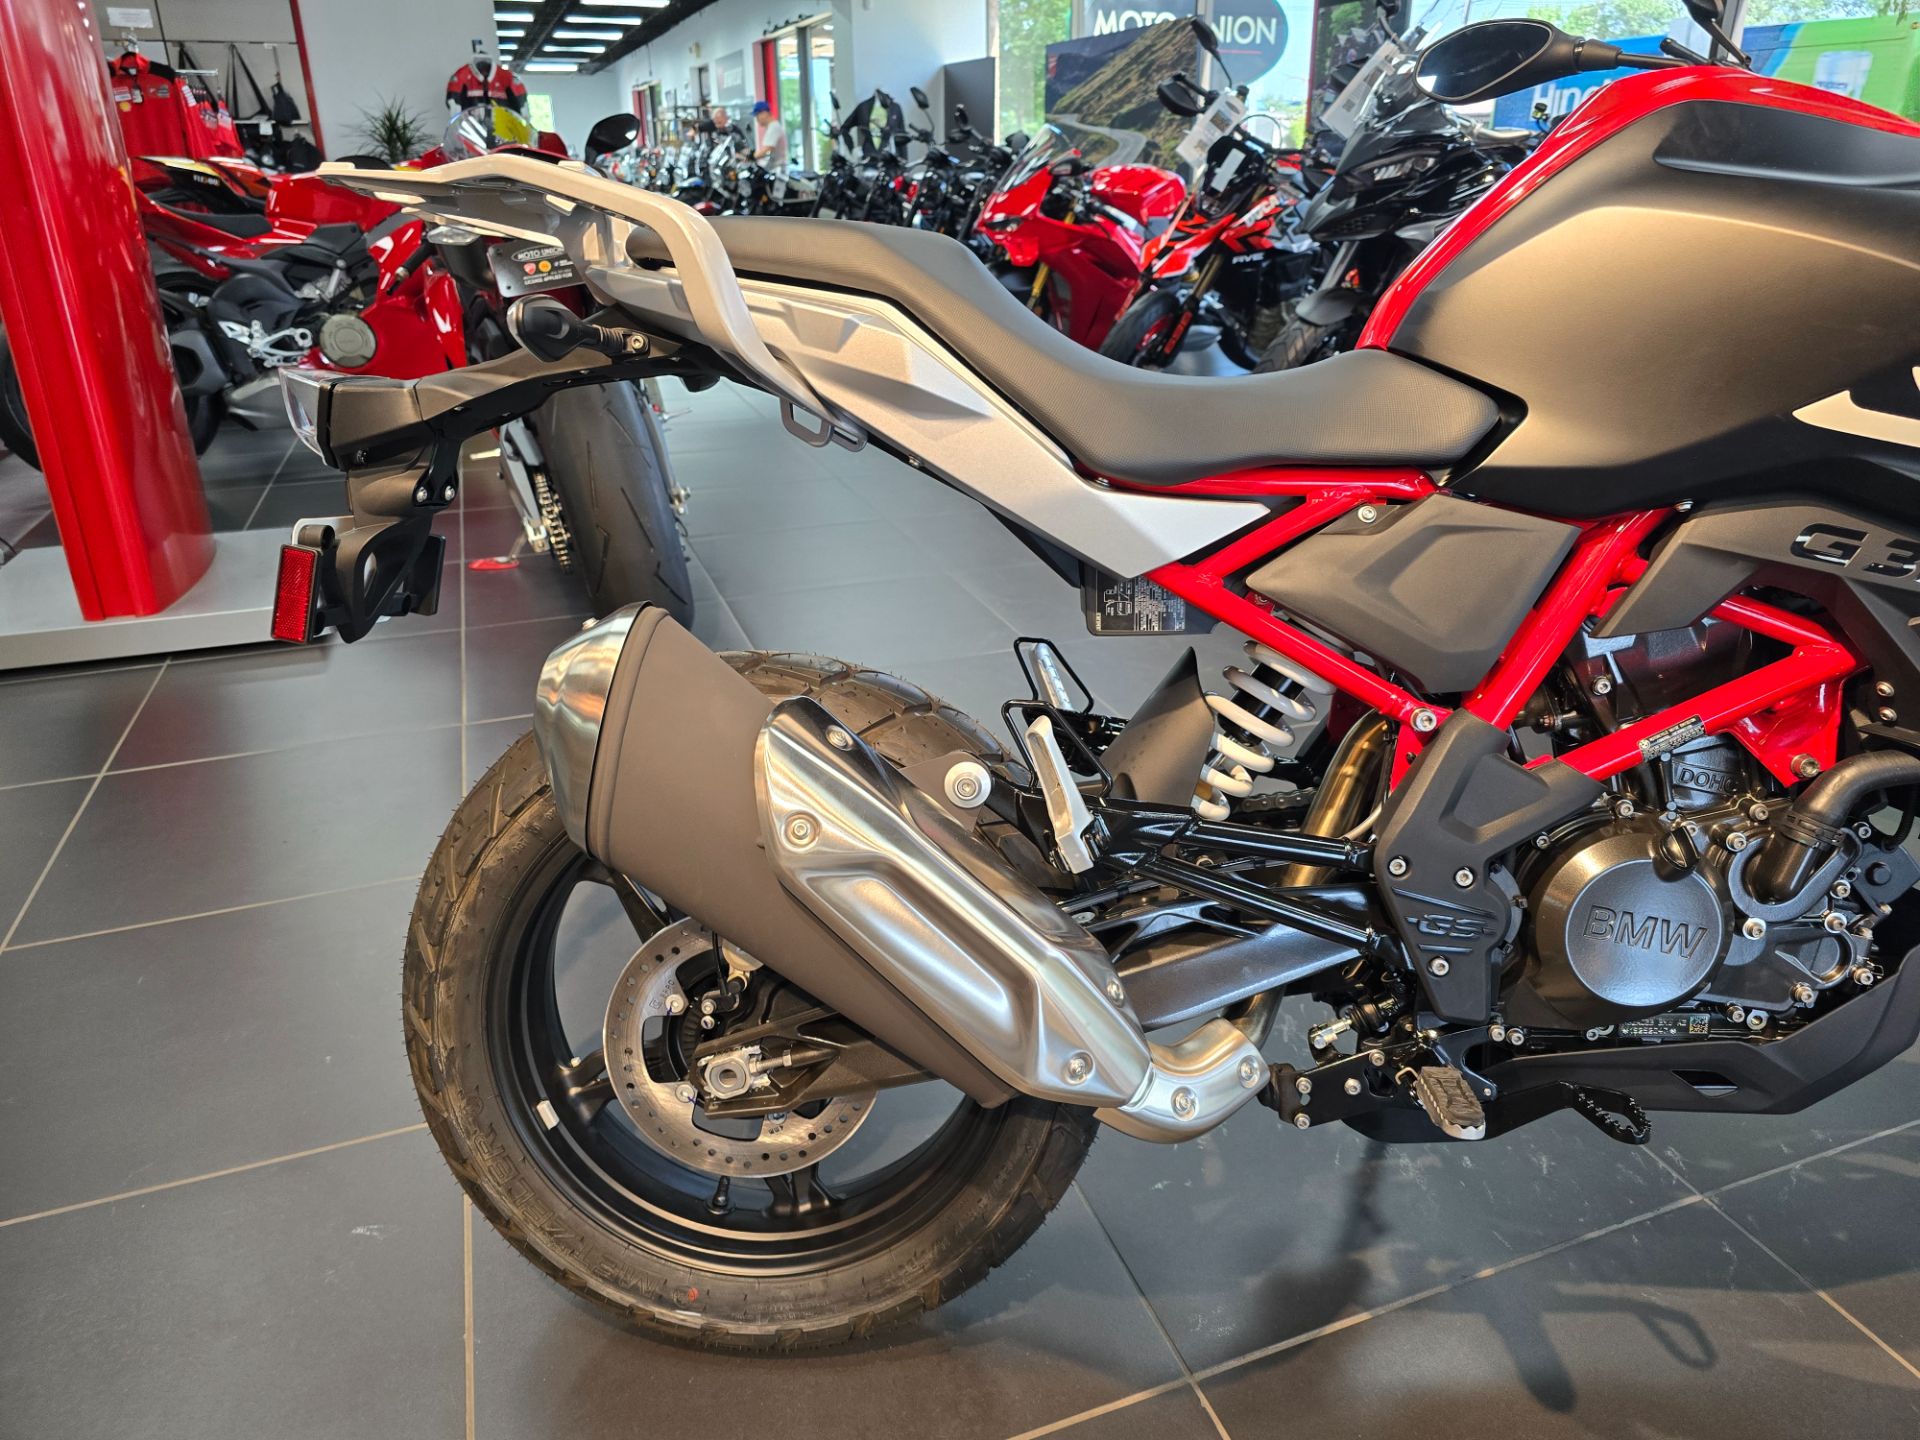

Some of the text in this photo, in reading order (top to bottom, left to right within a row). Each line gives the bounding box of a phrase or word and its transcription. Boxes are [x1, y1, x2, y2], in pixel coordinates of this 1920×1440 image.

[518, 249, 540, 260] MOTO
[1790, 523, 1920, 583] G3
[1582, 904, 1709, 961] BMW
